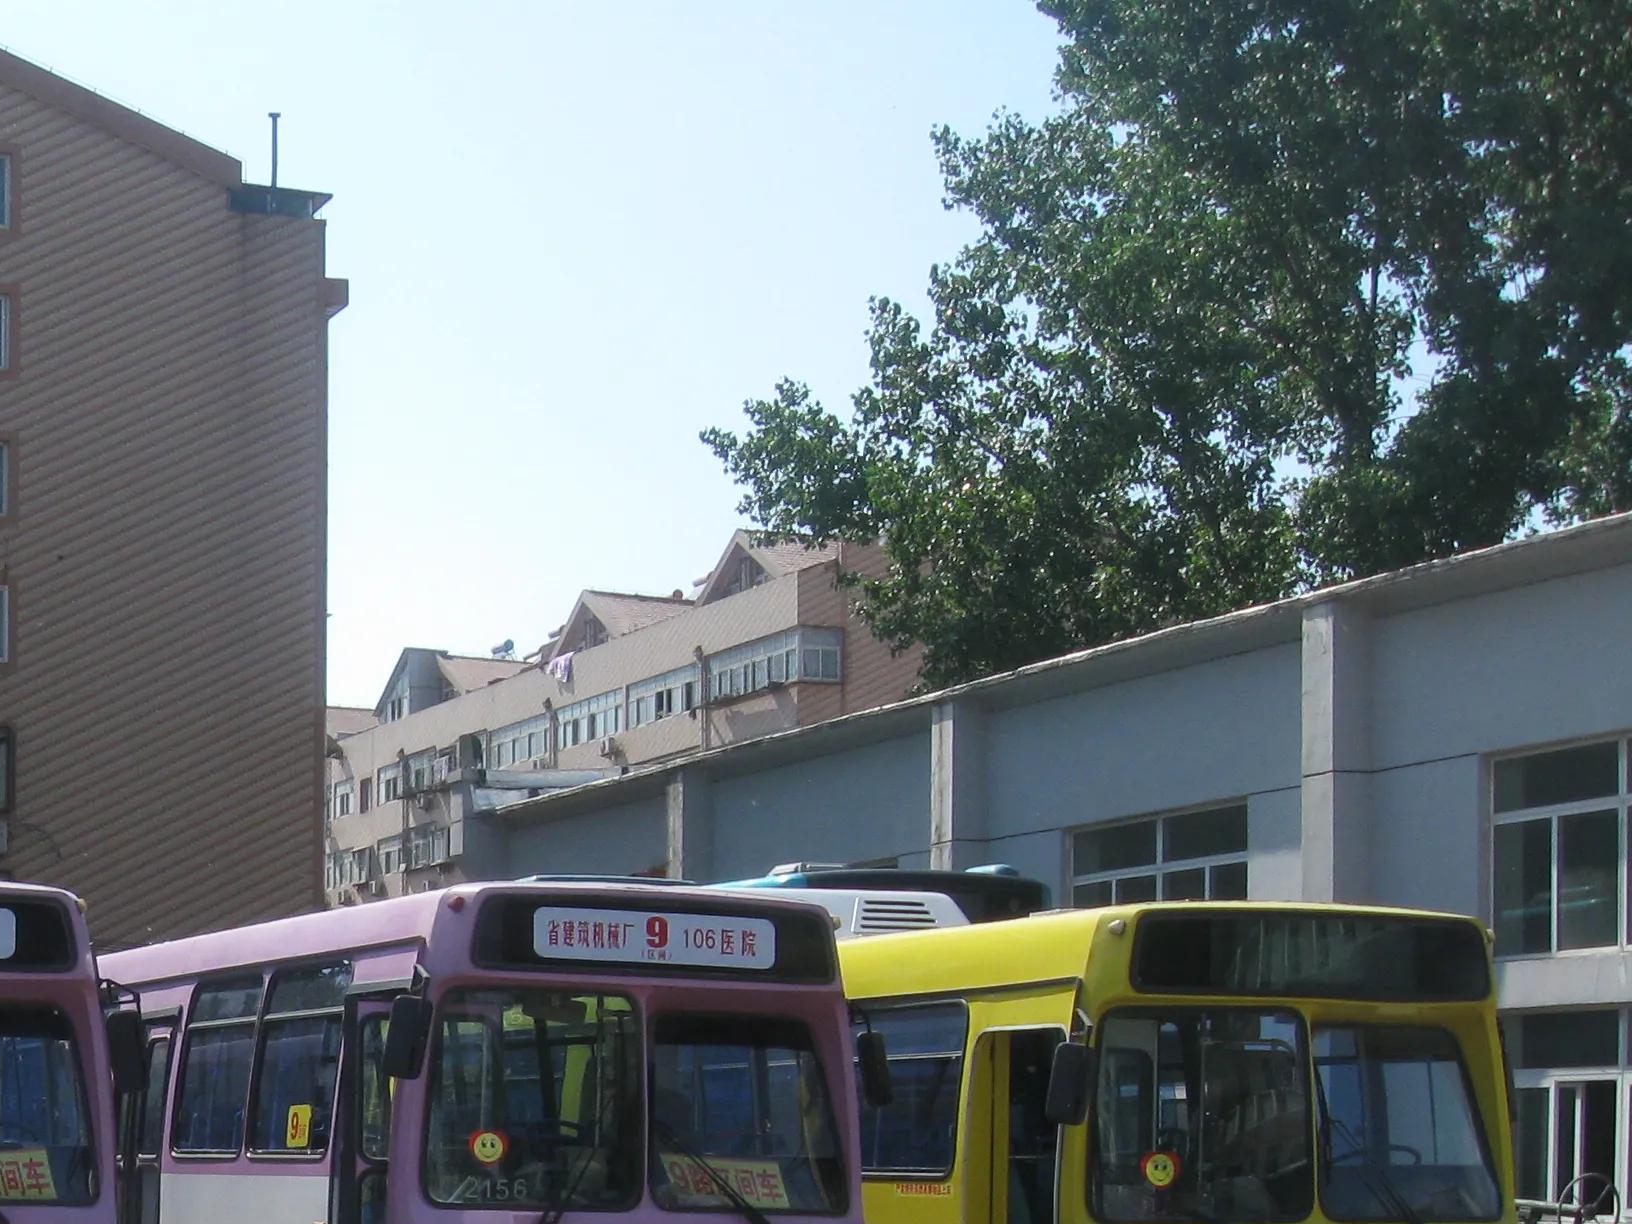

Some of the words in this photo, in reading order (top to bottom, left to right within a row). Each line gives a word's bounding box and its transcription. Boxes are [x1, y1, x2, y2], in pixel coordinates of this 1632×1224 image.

[548, 920, 634, 949] 省建筑机械厂
[646, 916, 668, 948] 9
[291, 1112, 299, 1140] 9
[466, 1176, 527, 1200] 2156
